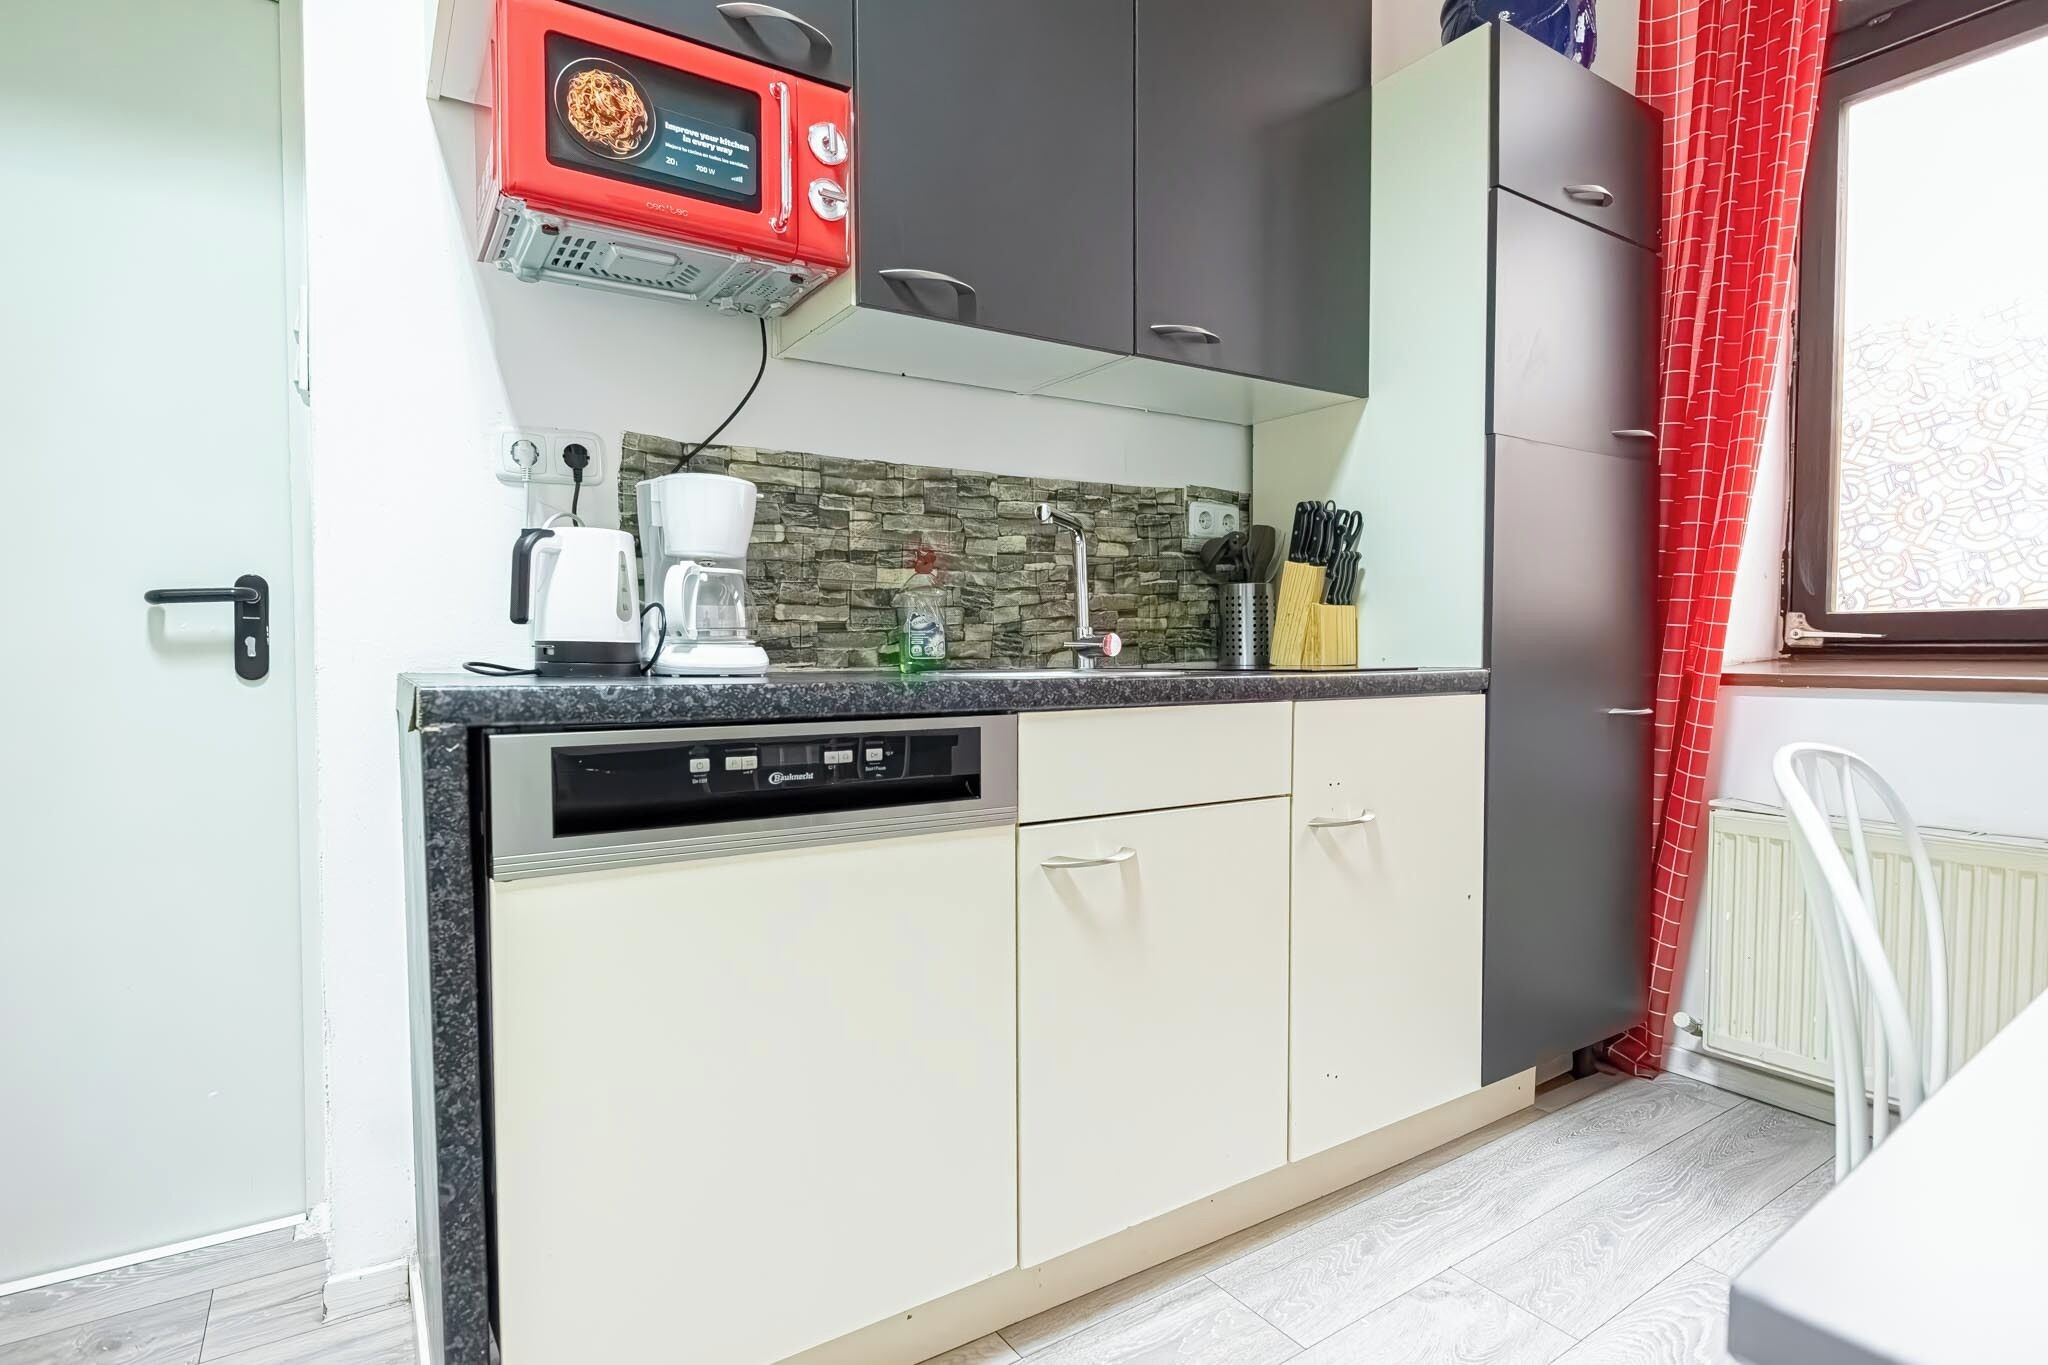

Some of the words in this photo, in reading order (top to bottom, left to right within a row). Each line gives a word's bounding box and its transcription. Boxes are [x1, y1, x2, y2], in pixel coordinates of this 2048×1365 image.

[665, 121, 699, 137] Improve
[699, 132, 719, 143] your
[719, 136, 750, 152] kitchen
[692, 138, 716, 151] every
[716, 145, 733, 156] way
[768, 771, 814, 785] Bauknecht
